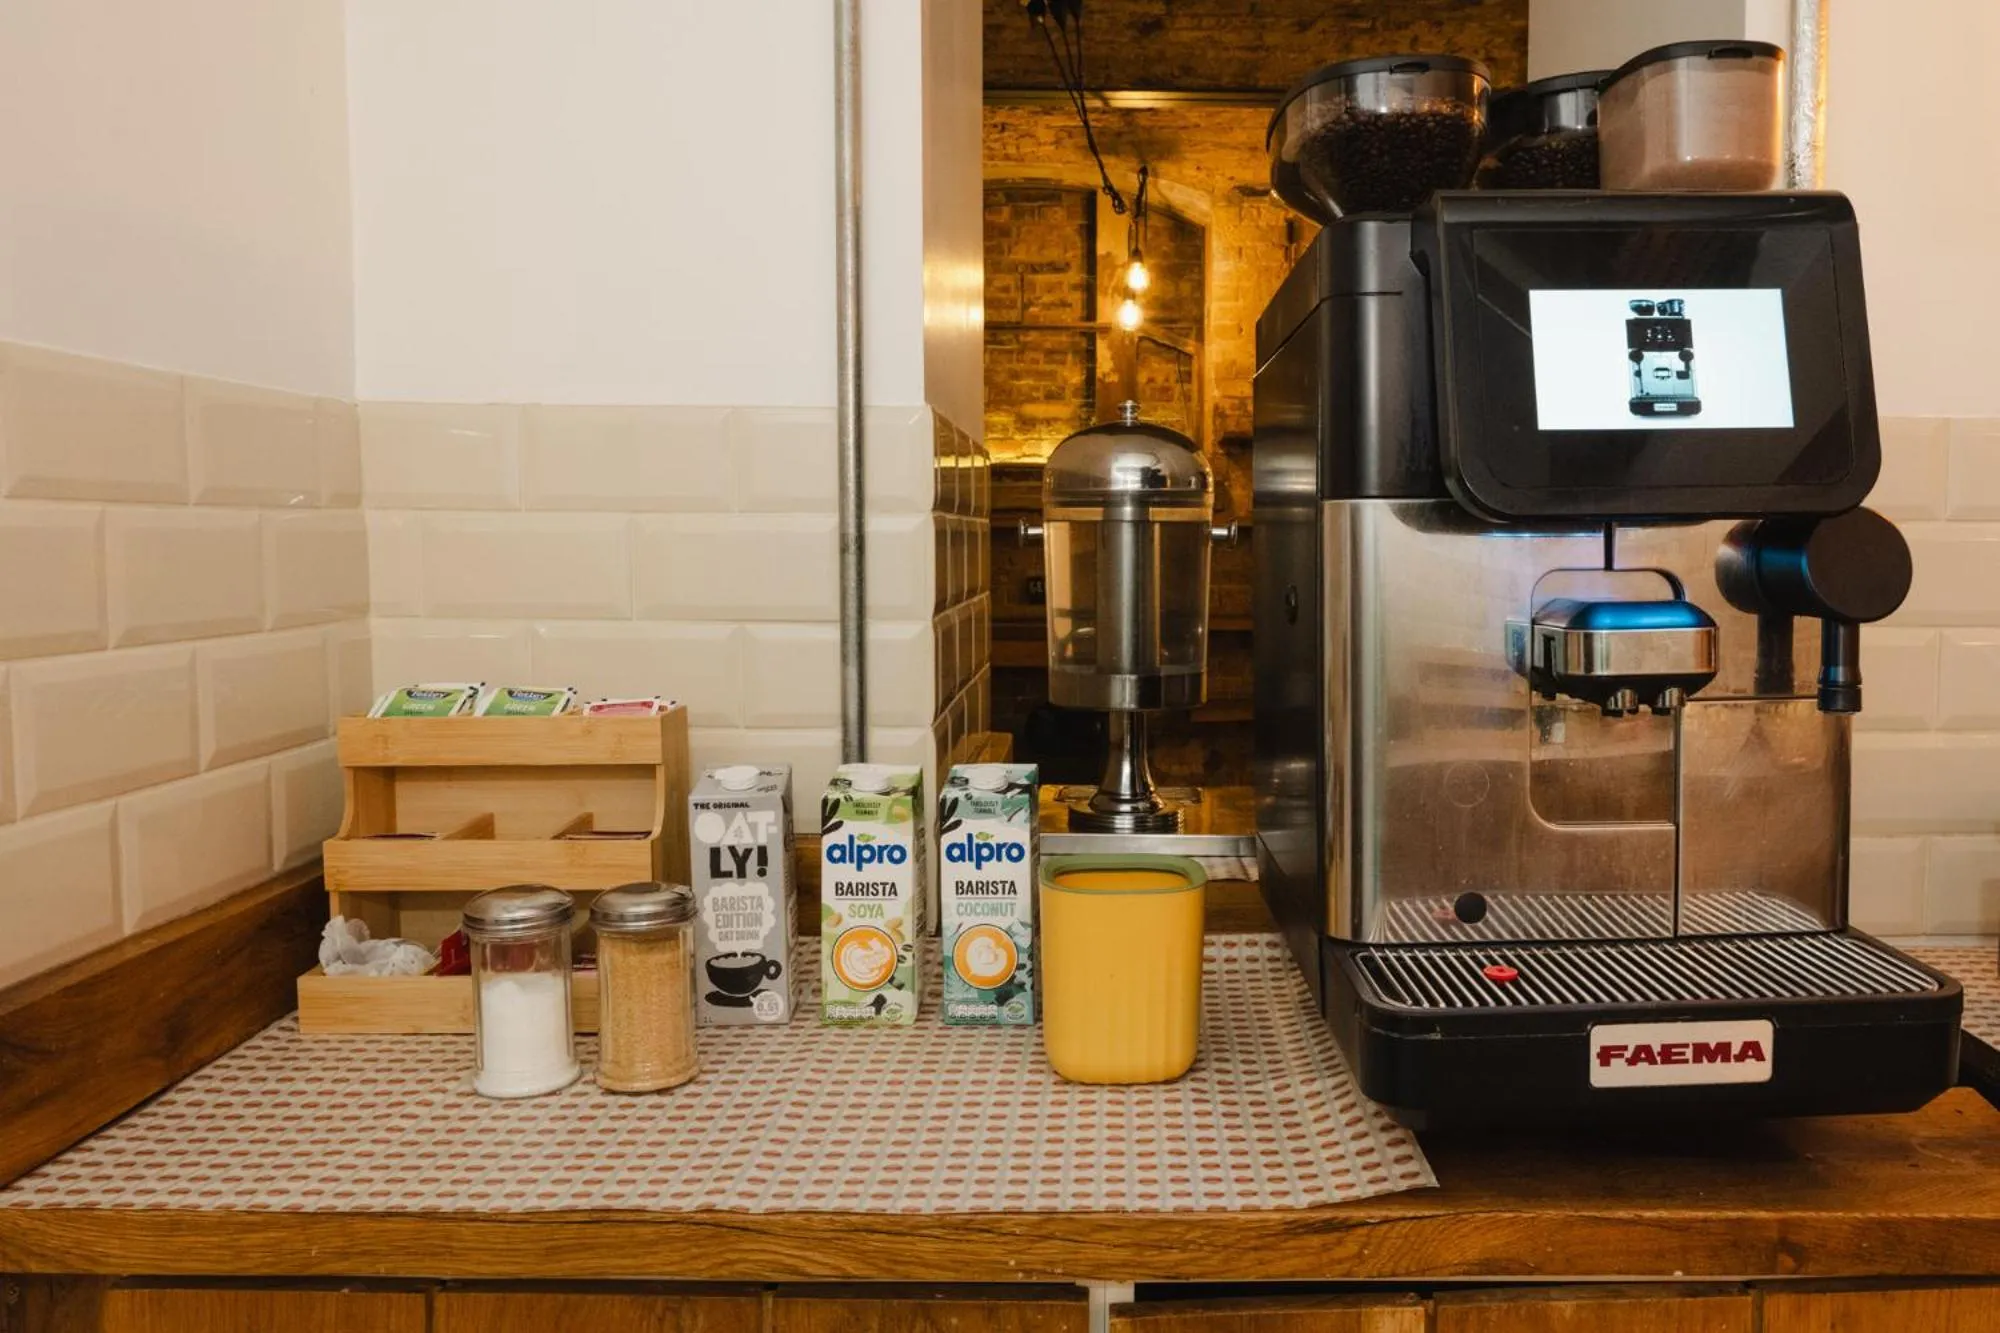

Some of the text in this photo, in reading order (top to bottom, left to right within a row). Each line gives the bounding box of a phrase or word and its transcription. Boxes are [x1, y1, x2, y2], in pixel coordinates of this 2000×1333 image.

[693, 802, 711, 810] THE
[826, 833, 907, 872] alpro
[945, 832, 1025, 870] alpro
[709, 845, 768, 879] LY!
[834, 881, 898, 897] BARISTA
[955, 880, 1017, 896] BARISTA
[712, 895, 765, 912] BARISTA
[847, 903, 885, 919] SOYA
[956, 902, 1017, 917] COCONUT
[715, 912, 764, 929] EDITION
[1596, 1041, 1766, 1067] FAEMA
